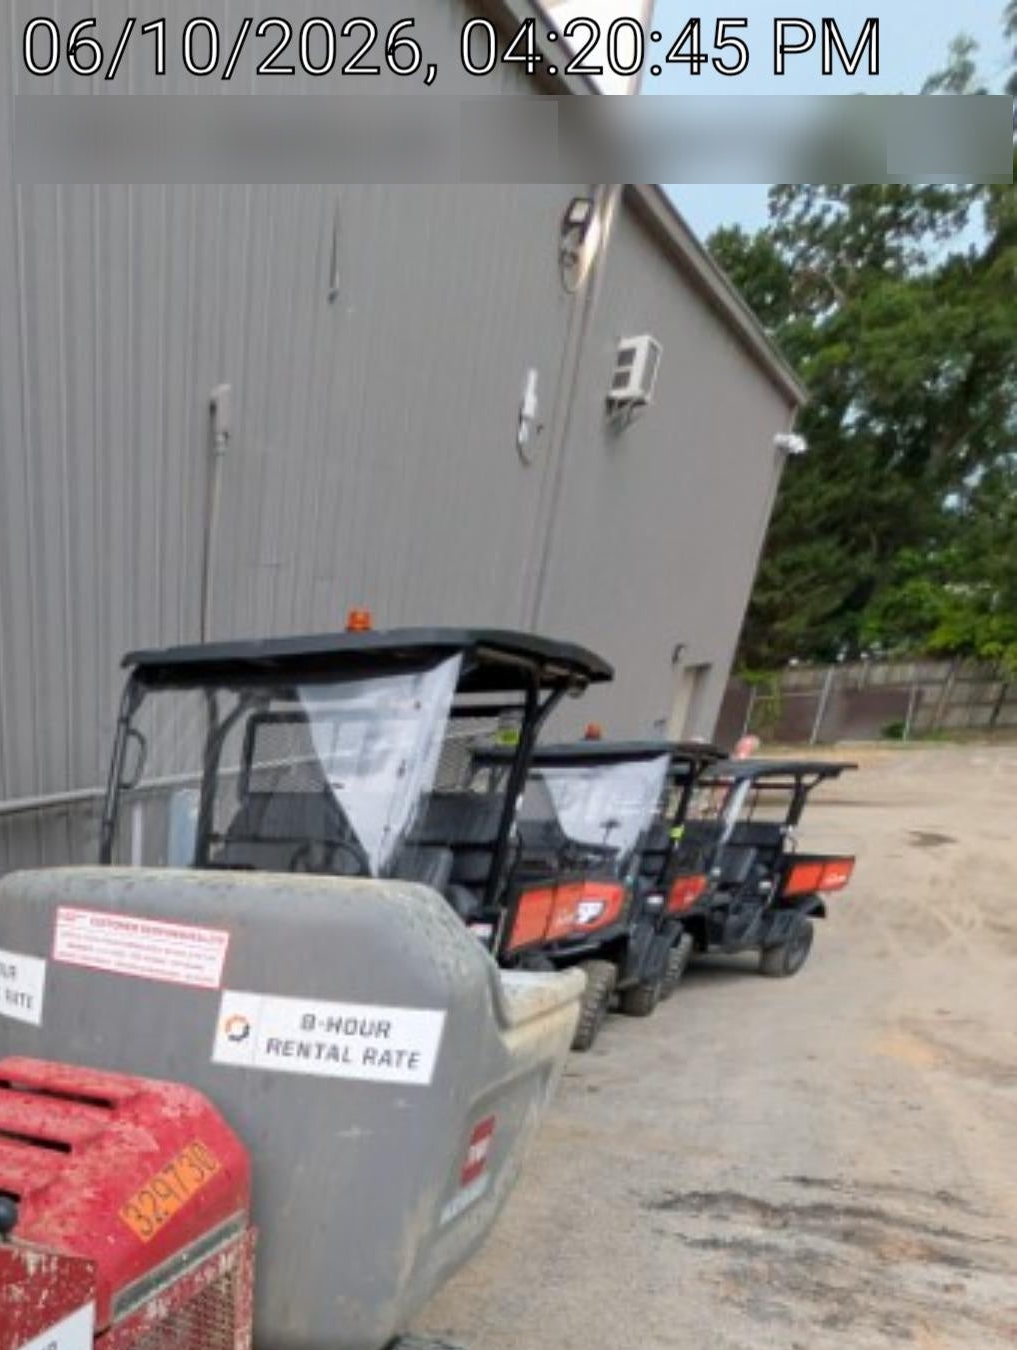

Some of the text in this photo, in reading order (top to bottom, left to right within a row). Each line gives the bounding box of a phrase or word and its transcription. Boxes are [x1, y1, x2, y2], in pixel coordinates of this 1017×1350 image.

[300, 1013, 392, 1039] 8-HOUR
[265, 1036, 423, 1070] RENTAL RATE
